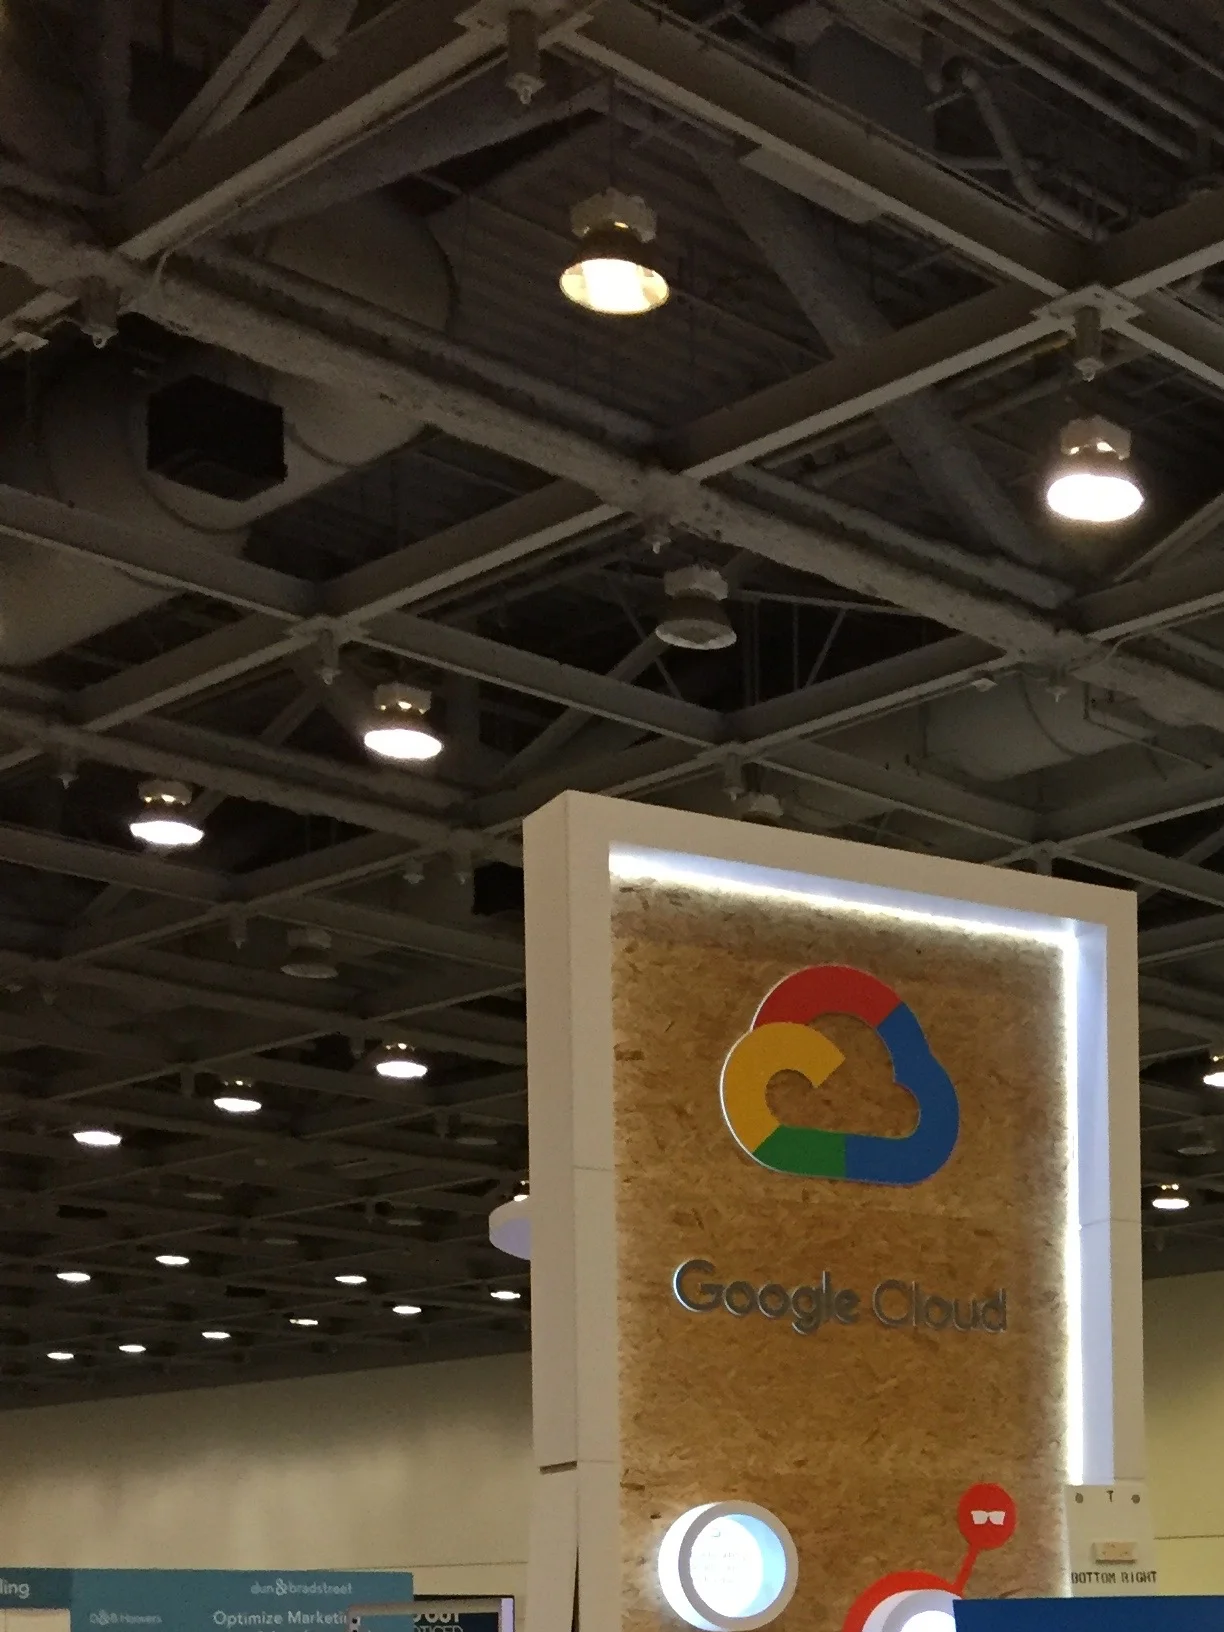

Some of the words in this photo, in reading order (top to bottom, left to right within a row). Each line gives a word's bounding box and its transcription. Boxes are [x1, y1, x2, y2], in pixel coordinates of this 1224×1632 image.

[672, 1258, 861, 1335] Google
[872, 1279, 1008, 1333] Cloud
[1071, 1572, 1117, 1584] BOTTOM
[1121, 1571, 1158, 1584] RIGHT
[213, 1609, 284, 1629] Optimize
